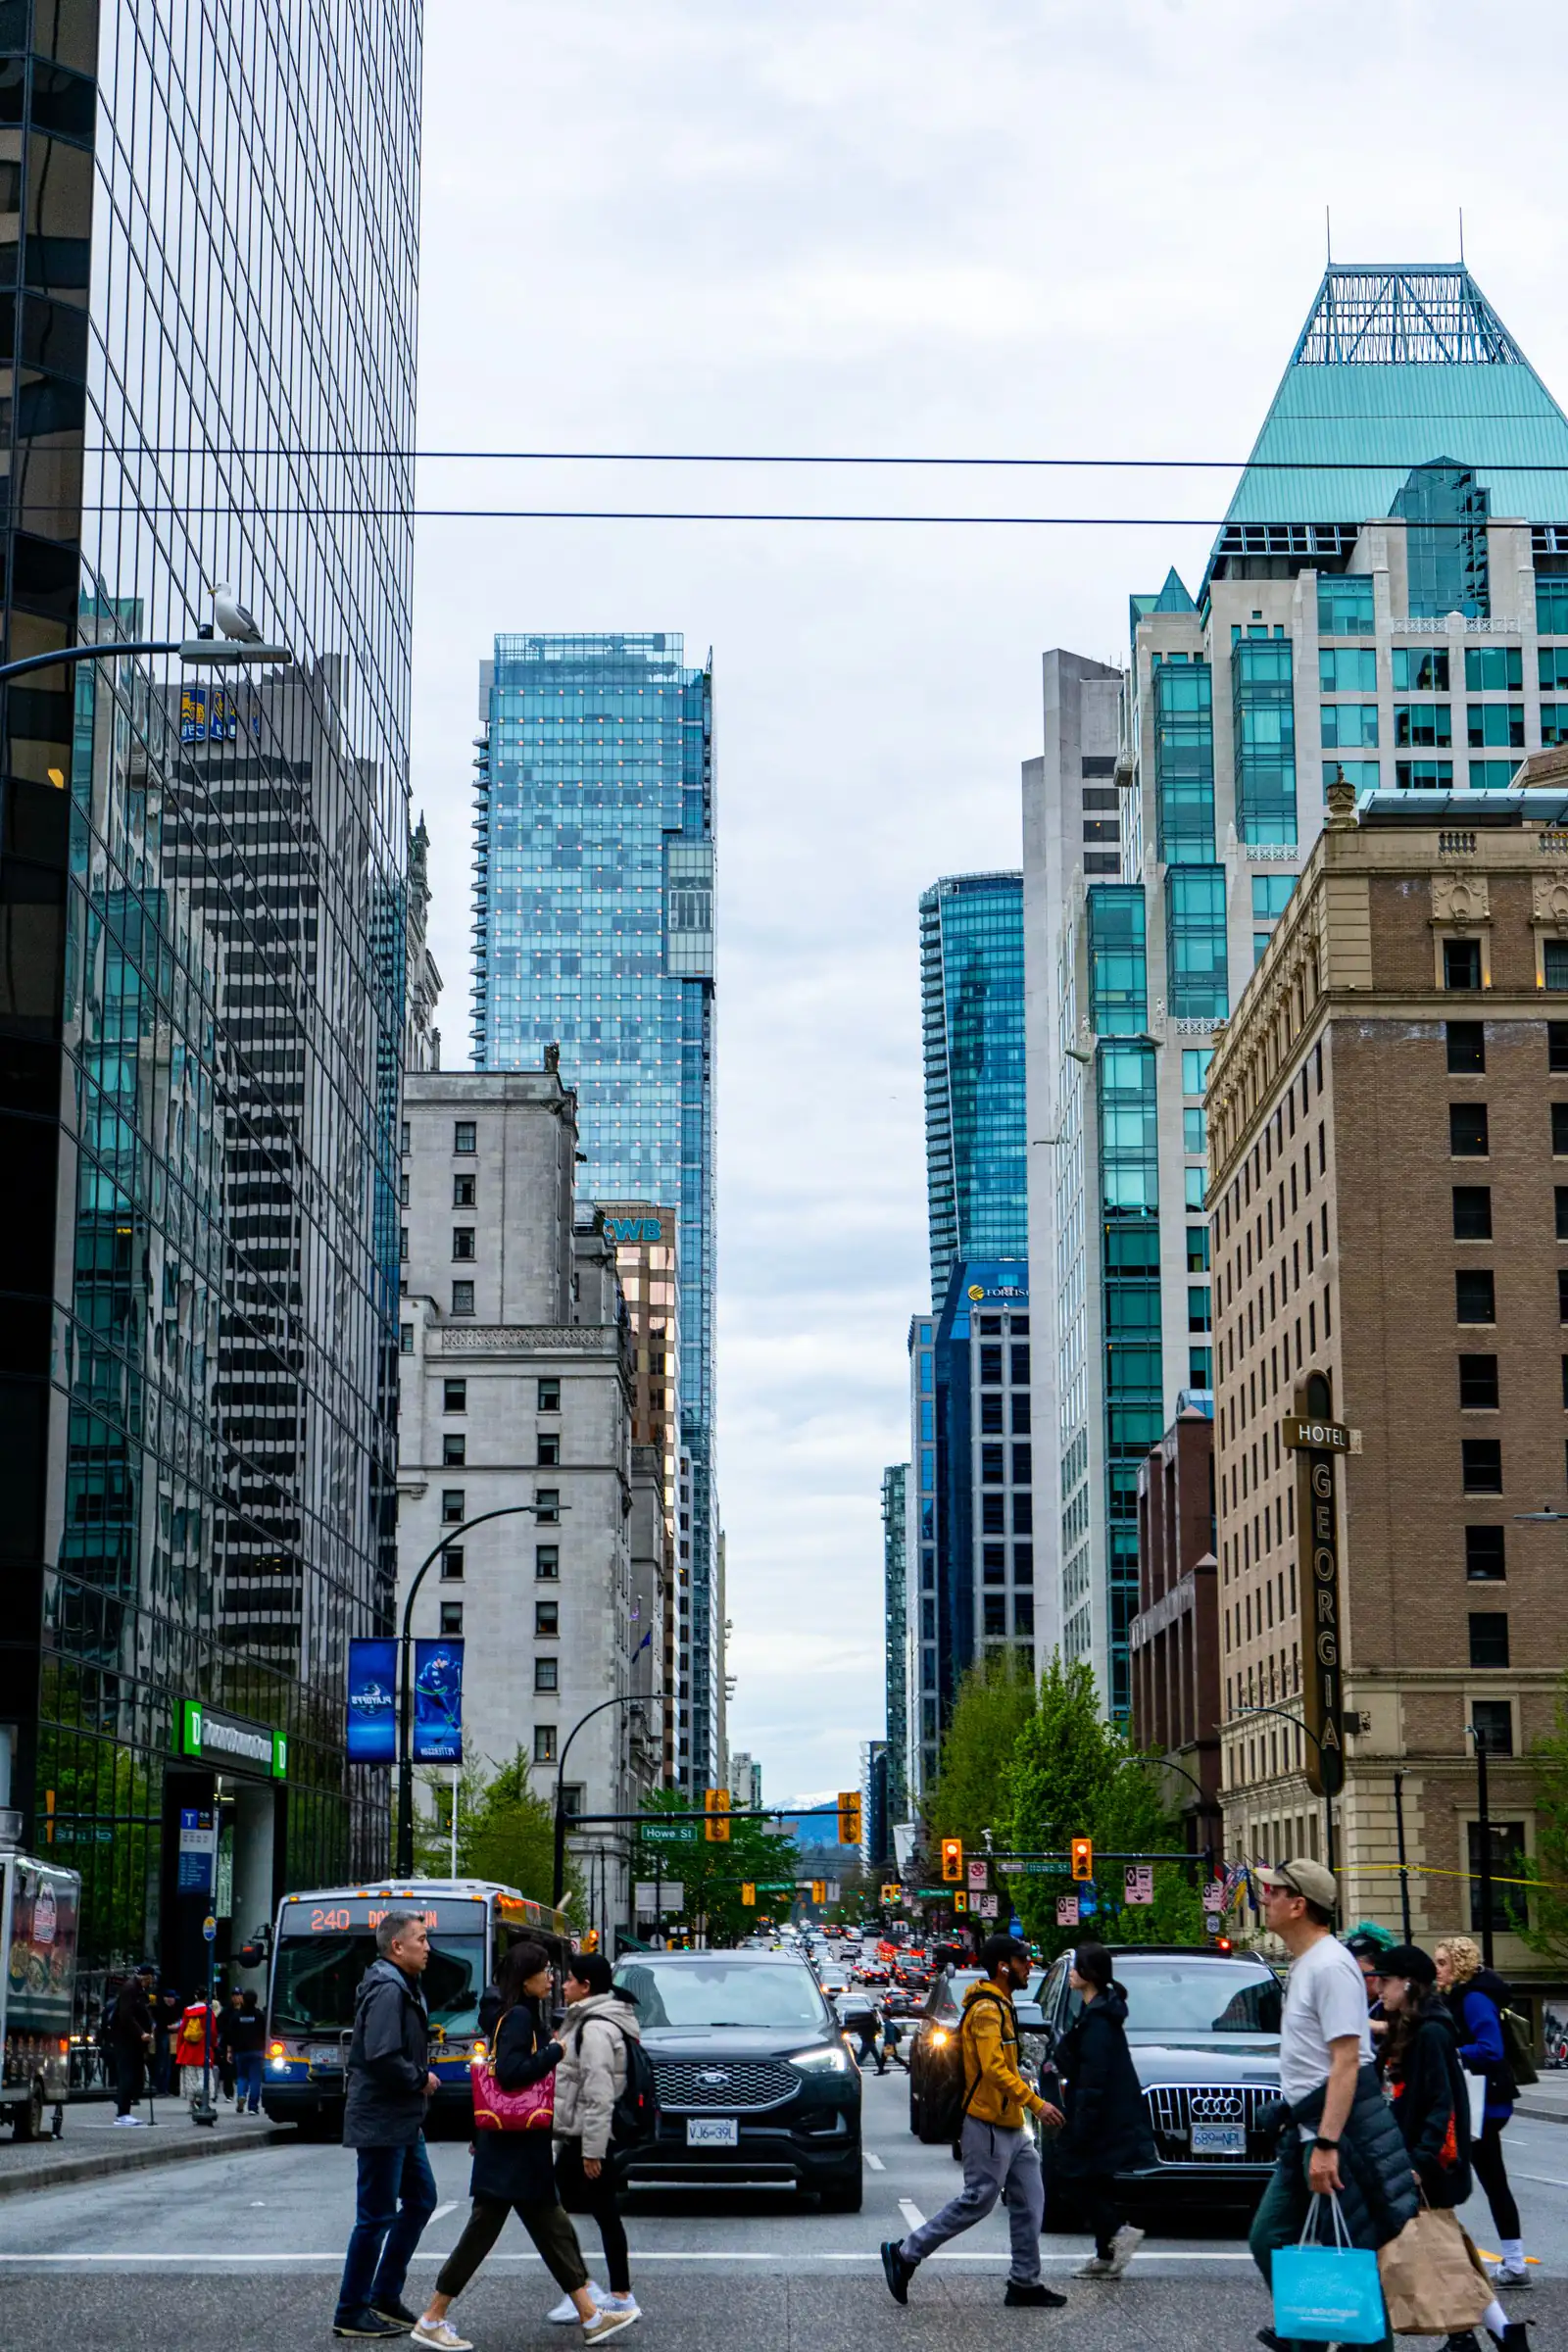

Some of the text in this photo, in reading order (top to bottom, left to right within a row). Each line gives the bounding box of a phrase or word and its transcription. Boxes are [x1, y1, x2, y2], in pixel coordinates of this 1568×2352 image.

[1298, 1424, 1346, 1447] HOTEL
[1311, 1462, 1341, 1750] GEORGIA
[646, 1828, 692, 1838] Howe St
[1057, 1863, 1067, 1872] St
[311, 1908, 351, 1931] 240
